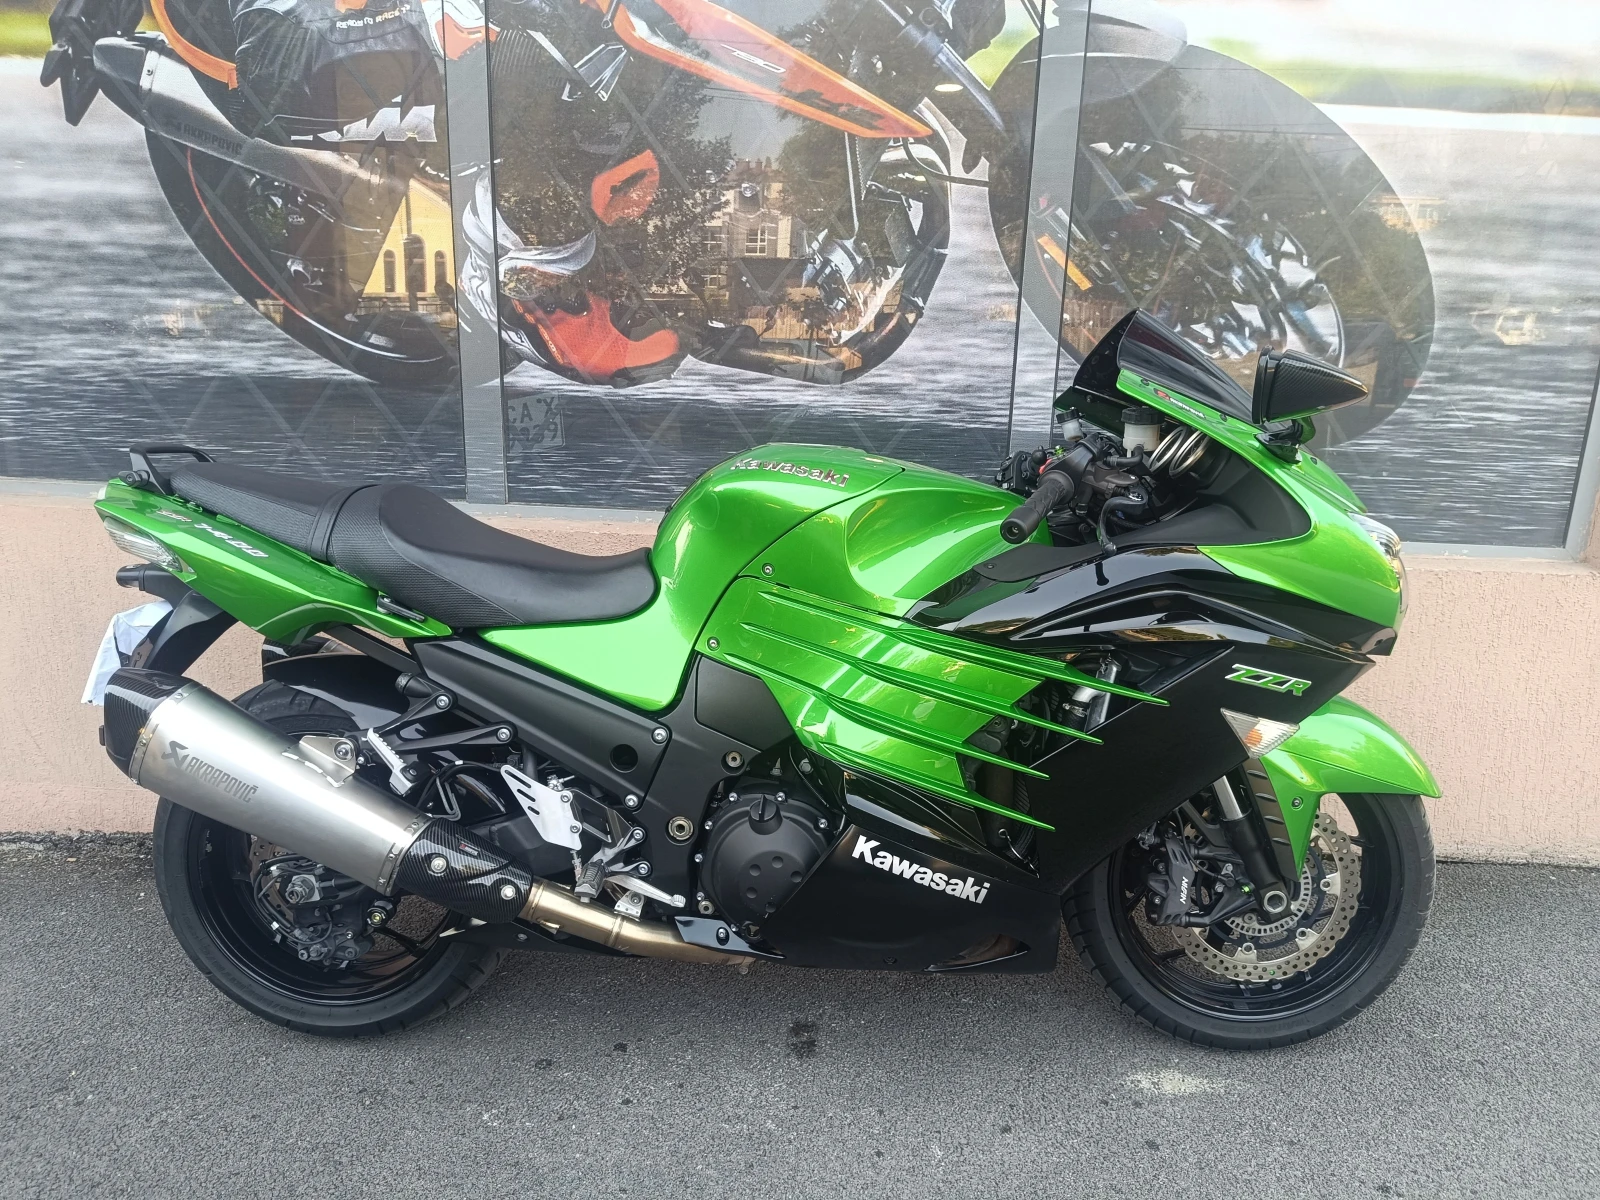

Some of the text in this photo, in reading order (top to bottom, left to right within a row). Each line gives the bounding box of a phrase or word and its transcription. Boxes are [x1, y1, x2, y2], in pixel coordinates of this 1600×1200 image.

[730, 458, 850, 488] Kawasaki
[1224, 663, 1312, 697] ZZR
[851, 834, 991, 905] Kawasaki
